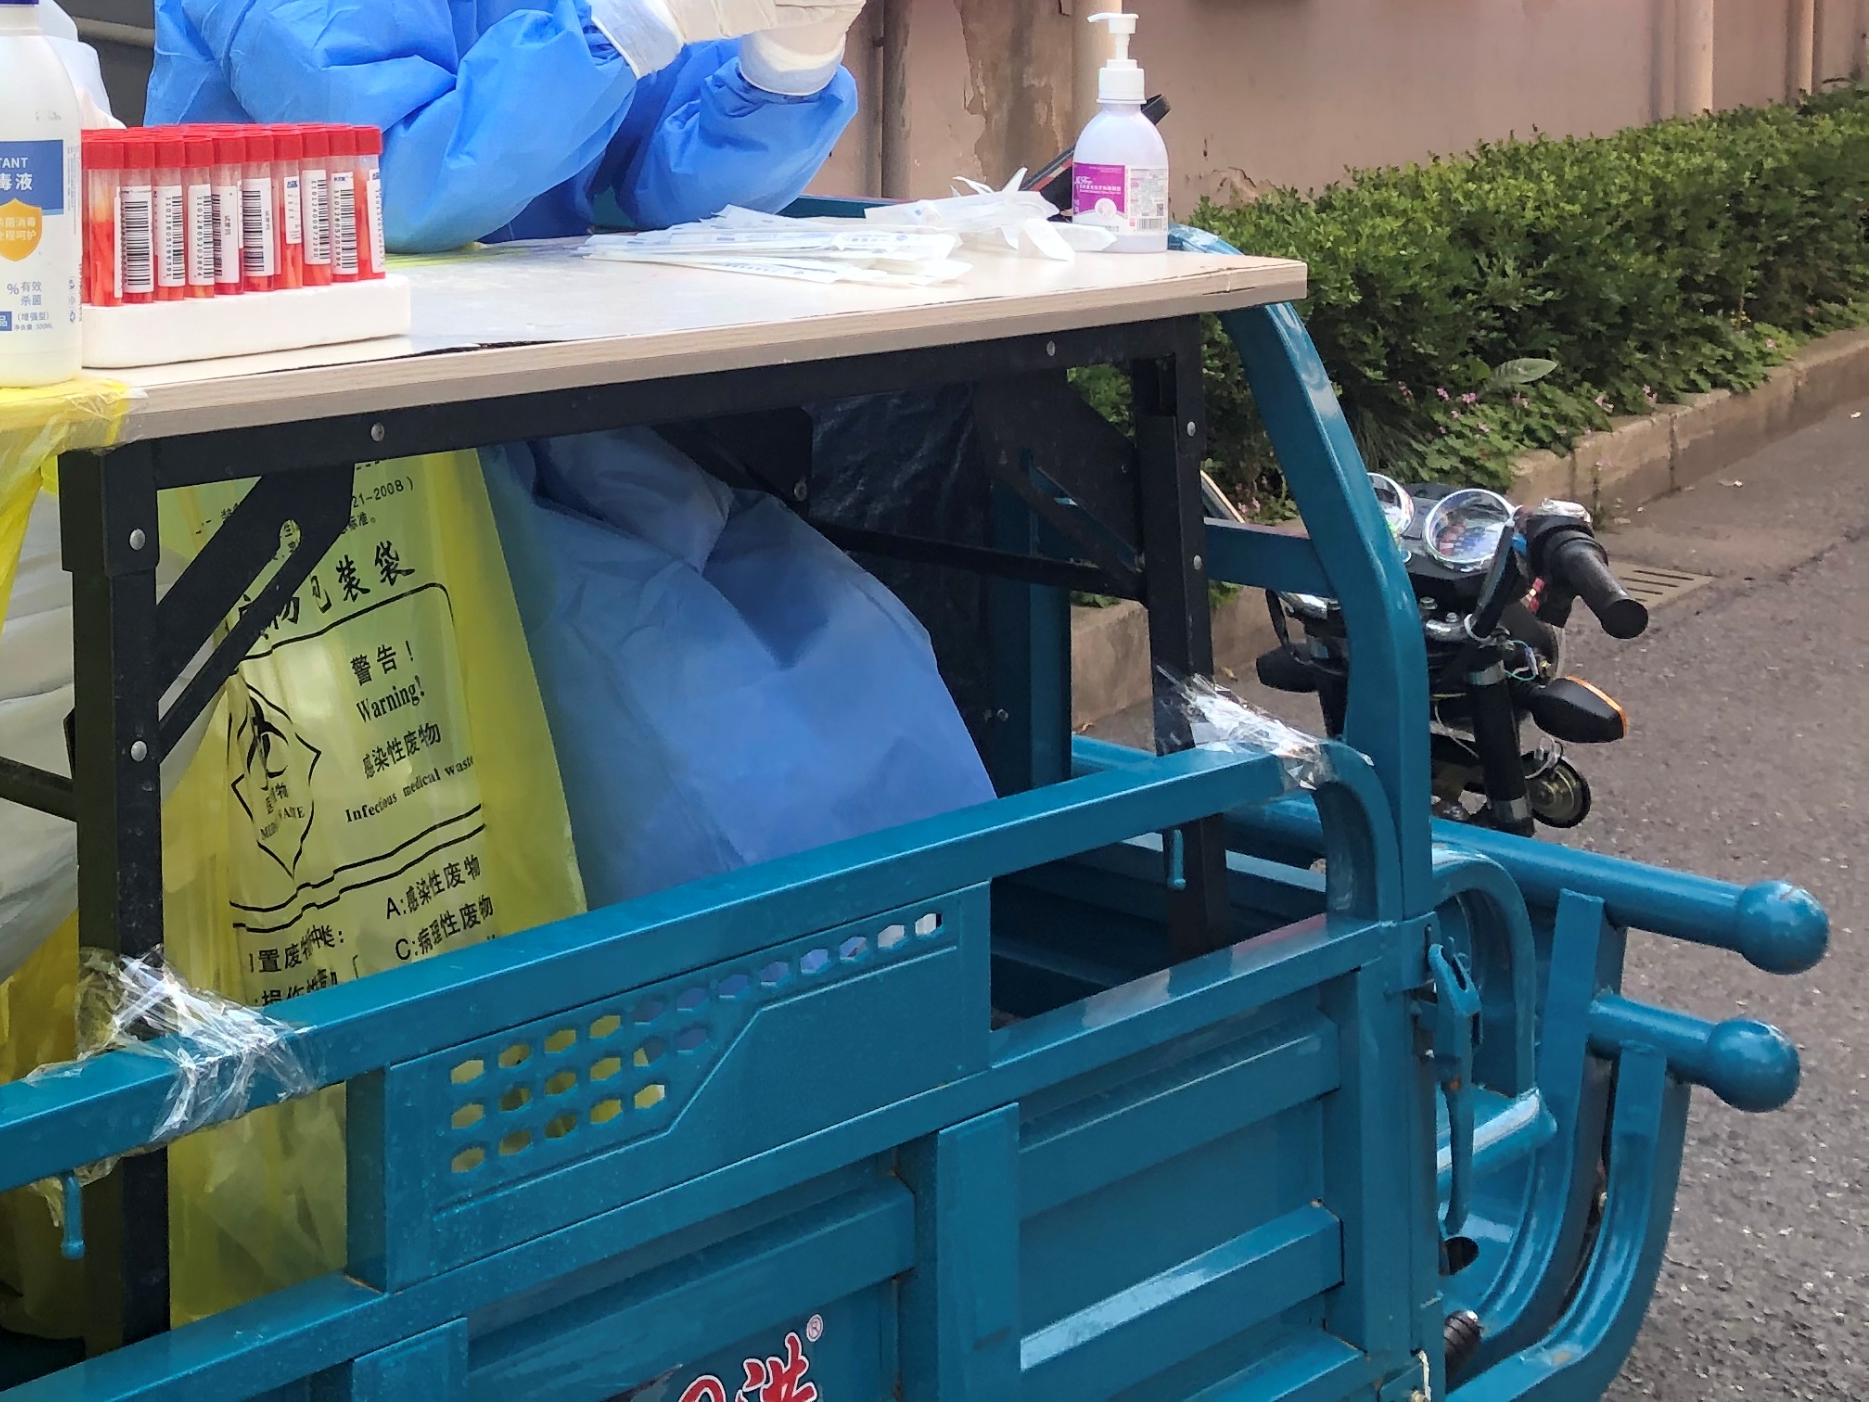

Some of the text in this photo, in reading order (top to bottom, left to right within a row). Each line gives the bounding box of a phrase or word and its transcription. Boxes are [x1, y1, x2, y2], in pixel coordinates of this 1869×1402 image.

[20, 281, 42, 293] 有效
[20, 295, 42, 306] 杀菌
[356, 674, 425, 724] Warning!
[362, 722, 442, 780] 感染性废物
